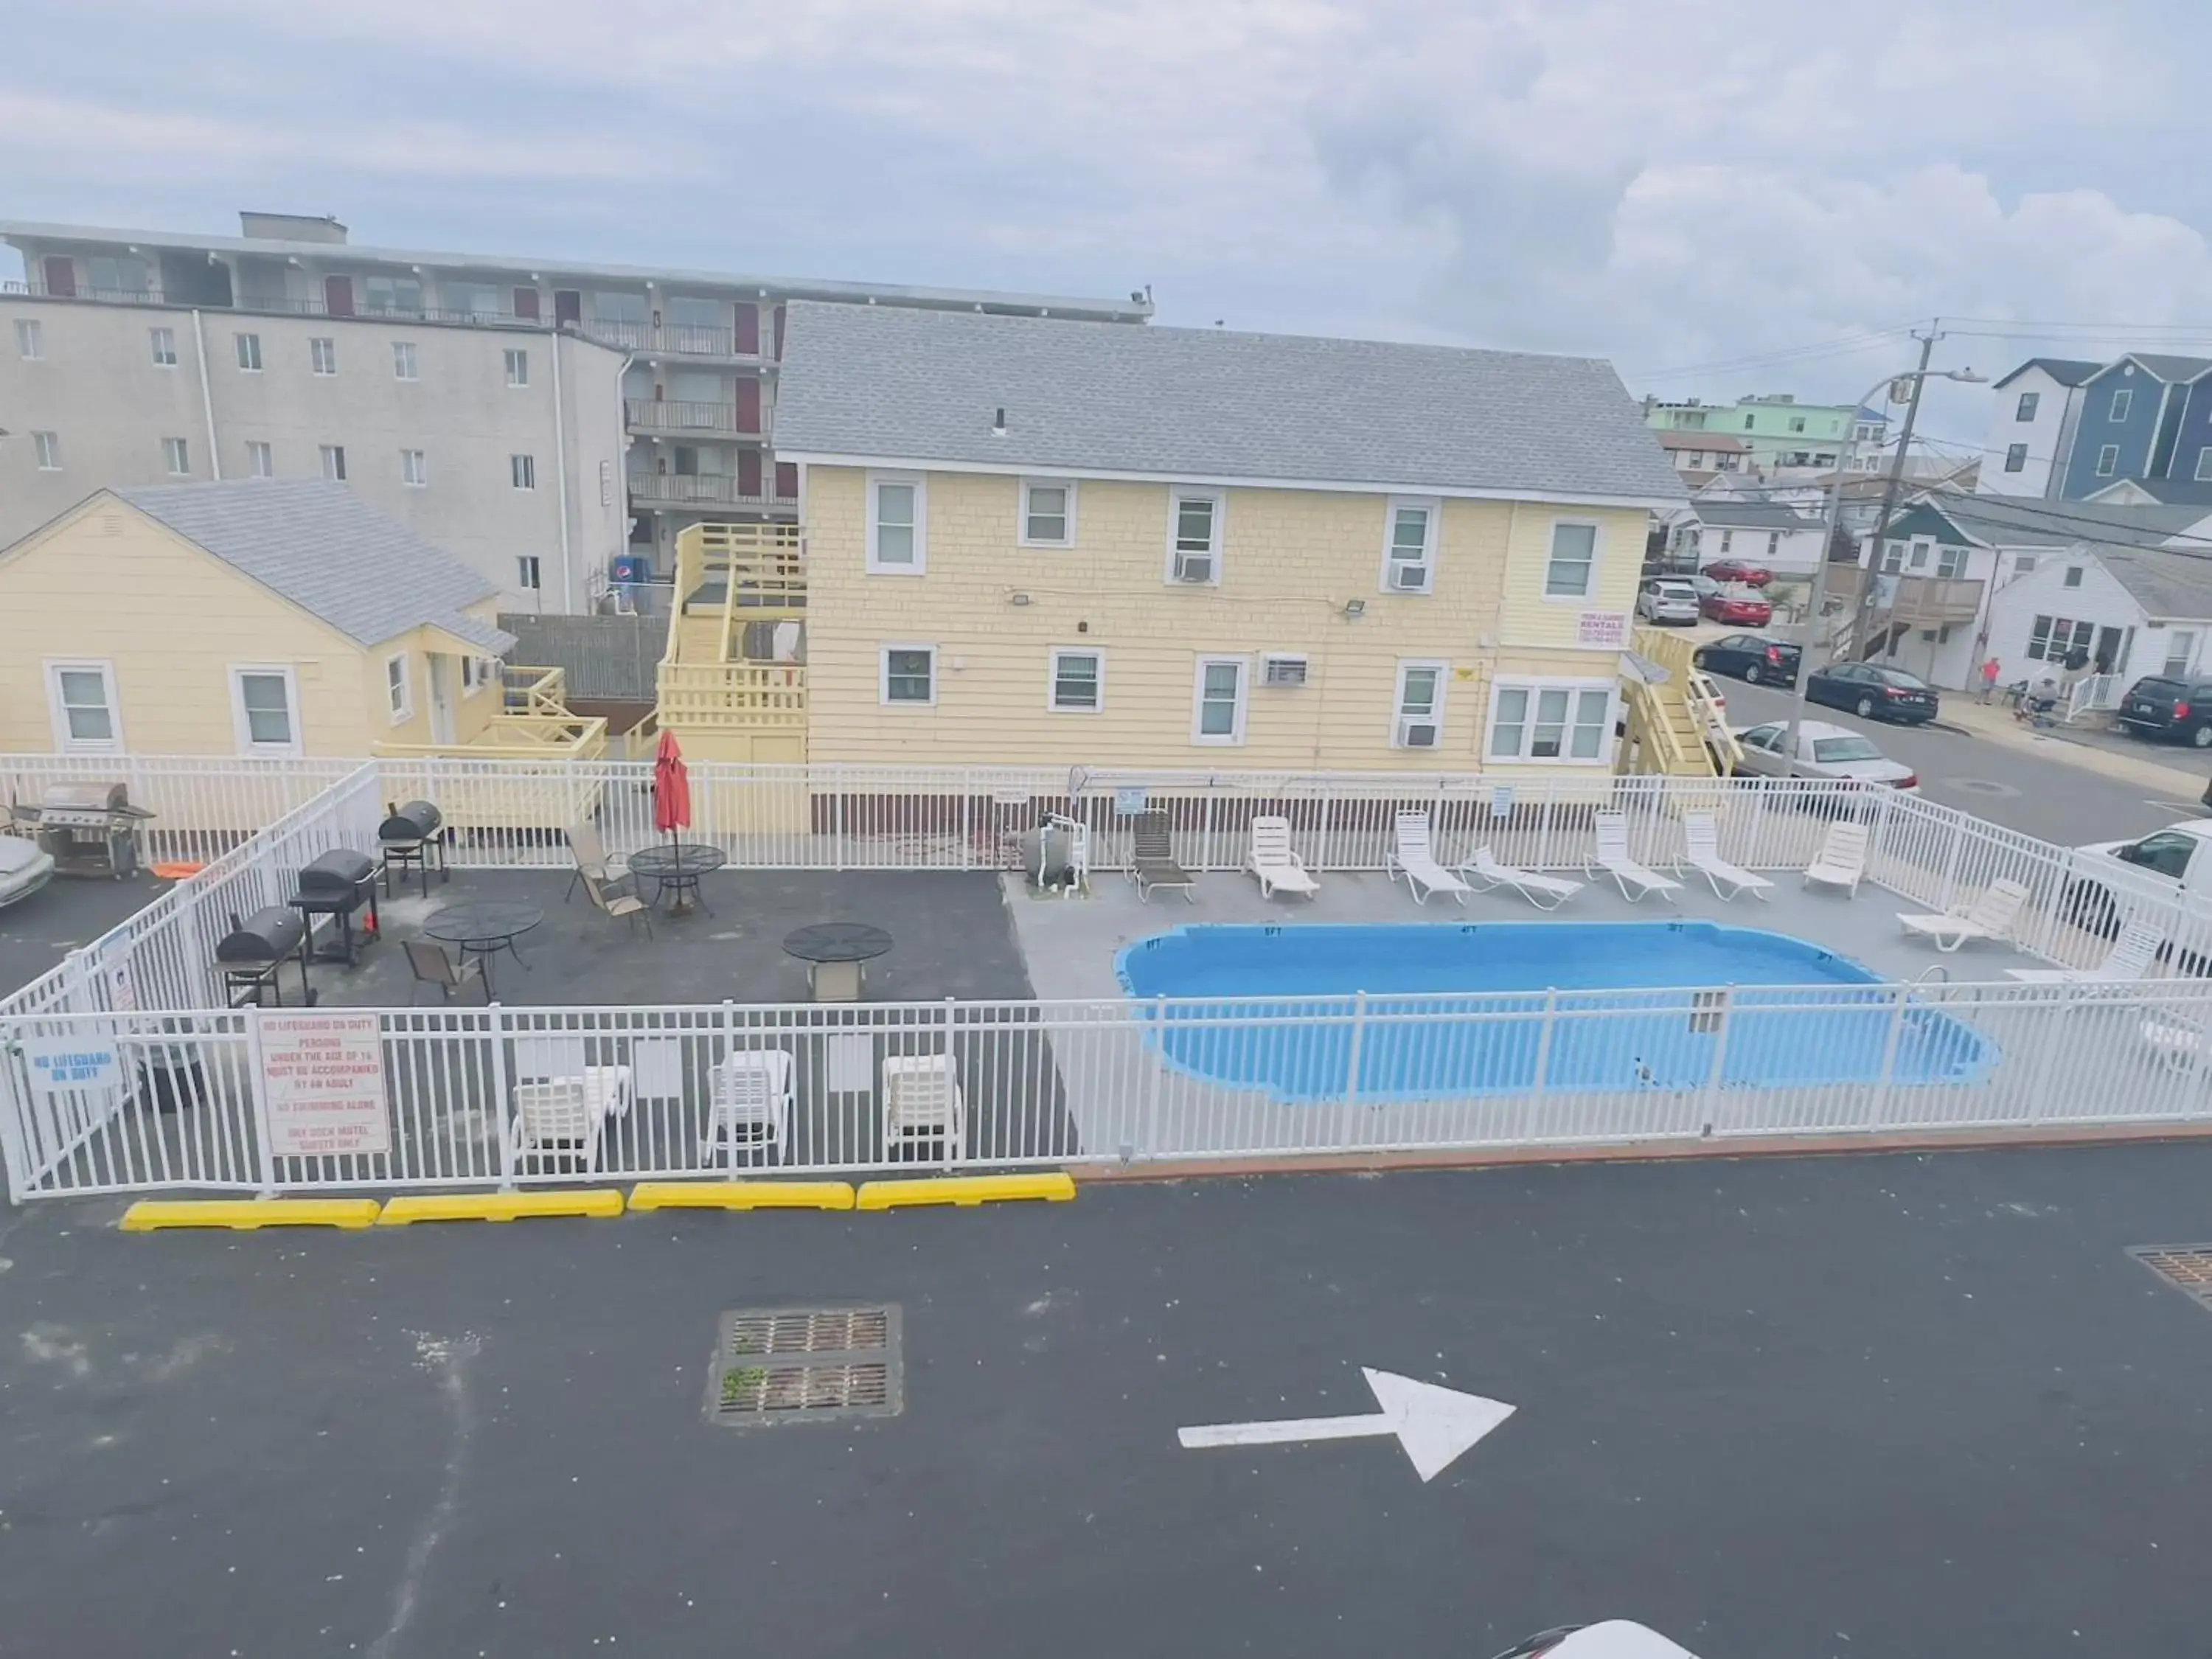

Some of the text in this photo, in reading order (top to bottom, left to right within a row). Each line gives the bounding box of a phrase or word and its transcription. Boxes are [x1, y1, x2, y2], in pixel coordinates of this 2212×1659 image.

[264, 1019, 372, 1031] NO LIFEGUARD ON DUTY
[33, 1051, 111, 1068] NO LIFEGUARD
[271, 1052, 302, 1062] UNDER
[305, 1051, 321, 1062] THE
[325, 1051, 343, 1060] AGE
[346, 1051, 357, 1060] OF
[52, 1067, 97, 1082] ON DUTY
[267, 1064, 379, 1077] MUST BE ACCOMPANIED
[294, 1078, 353, 1089] BY AN ADULT
[347, 1099, 376, 1110] ALONE
[338, 1125, 368, 1135] MOTEL
[338, 1138, 360, 1148] ONLY
